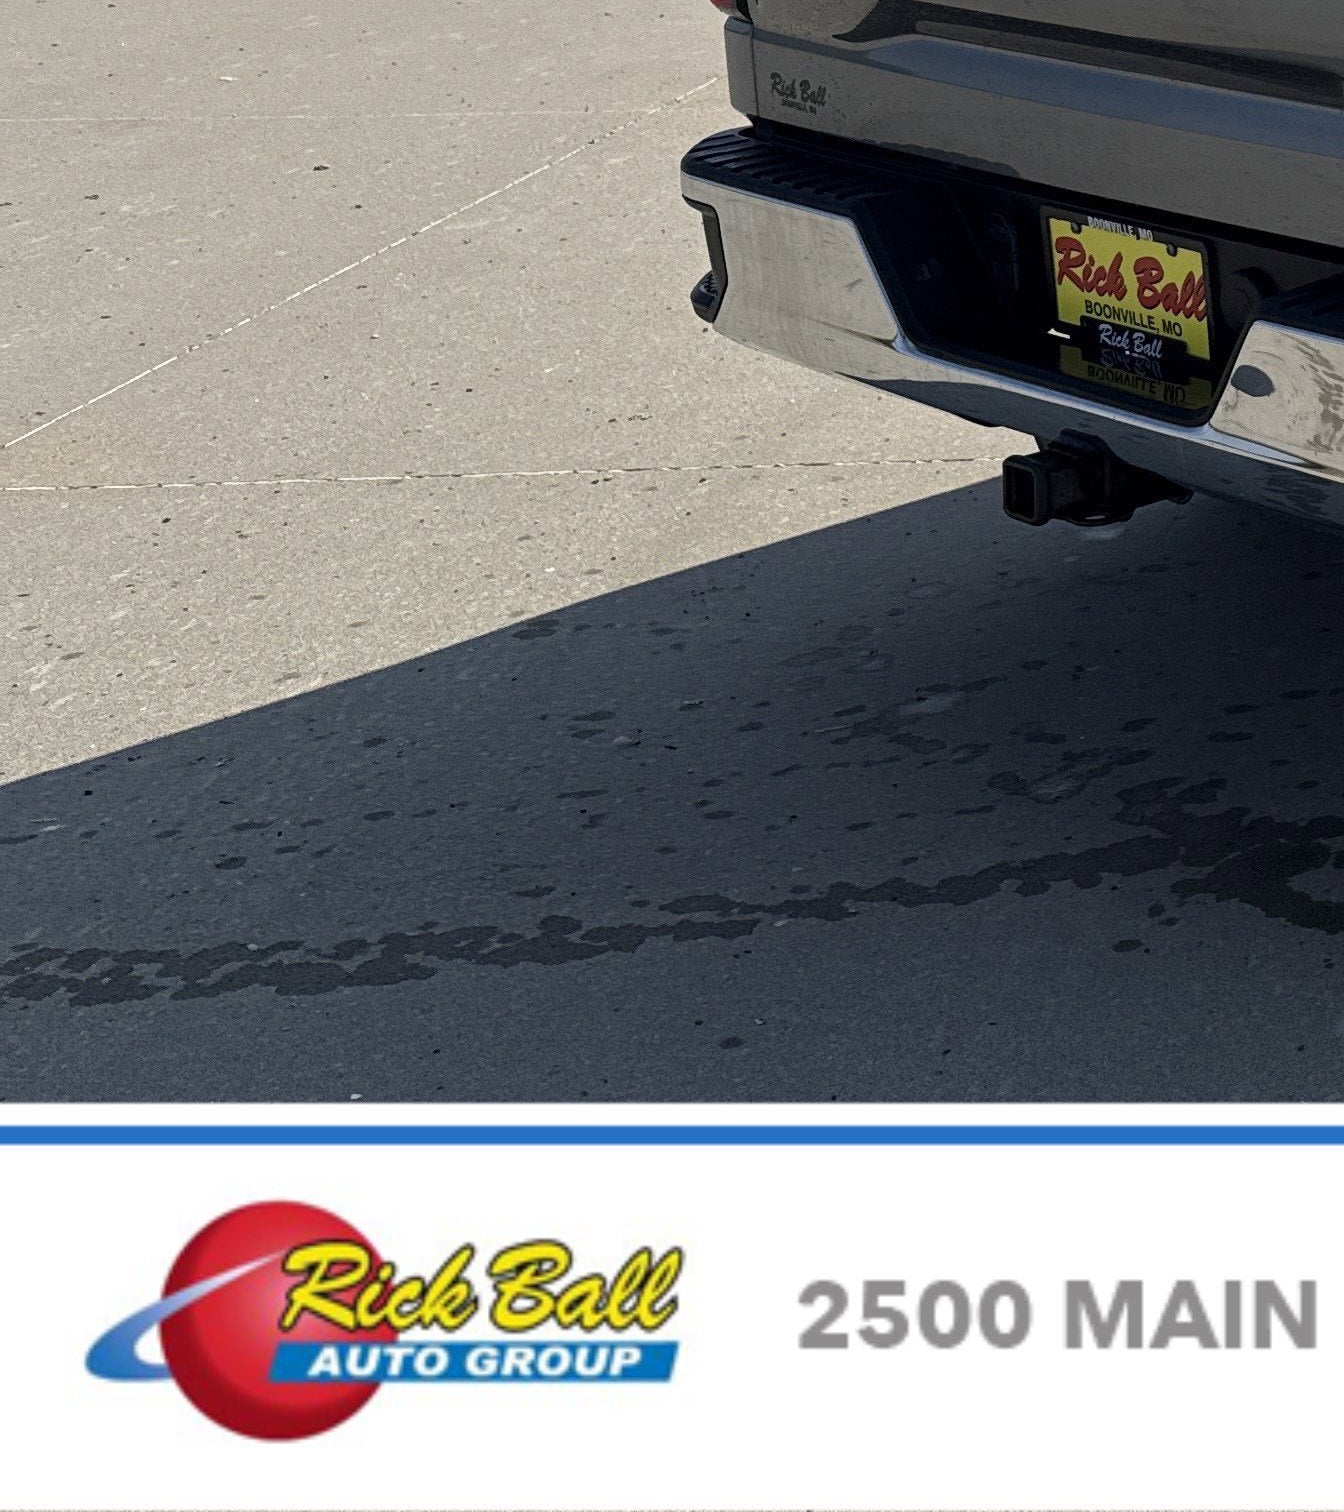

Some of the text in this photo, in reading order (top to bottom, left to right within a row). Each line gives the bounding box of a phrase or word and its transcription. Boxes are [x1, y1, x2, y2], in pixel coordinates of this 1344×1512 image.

[1055, 236, 1208, 322] Rick Ball
[1084, 299, 1182, 336] BOONVILLE, MO
[1098, 323, 1163, 359] Rick Ball
